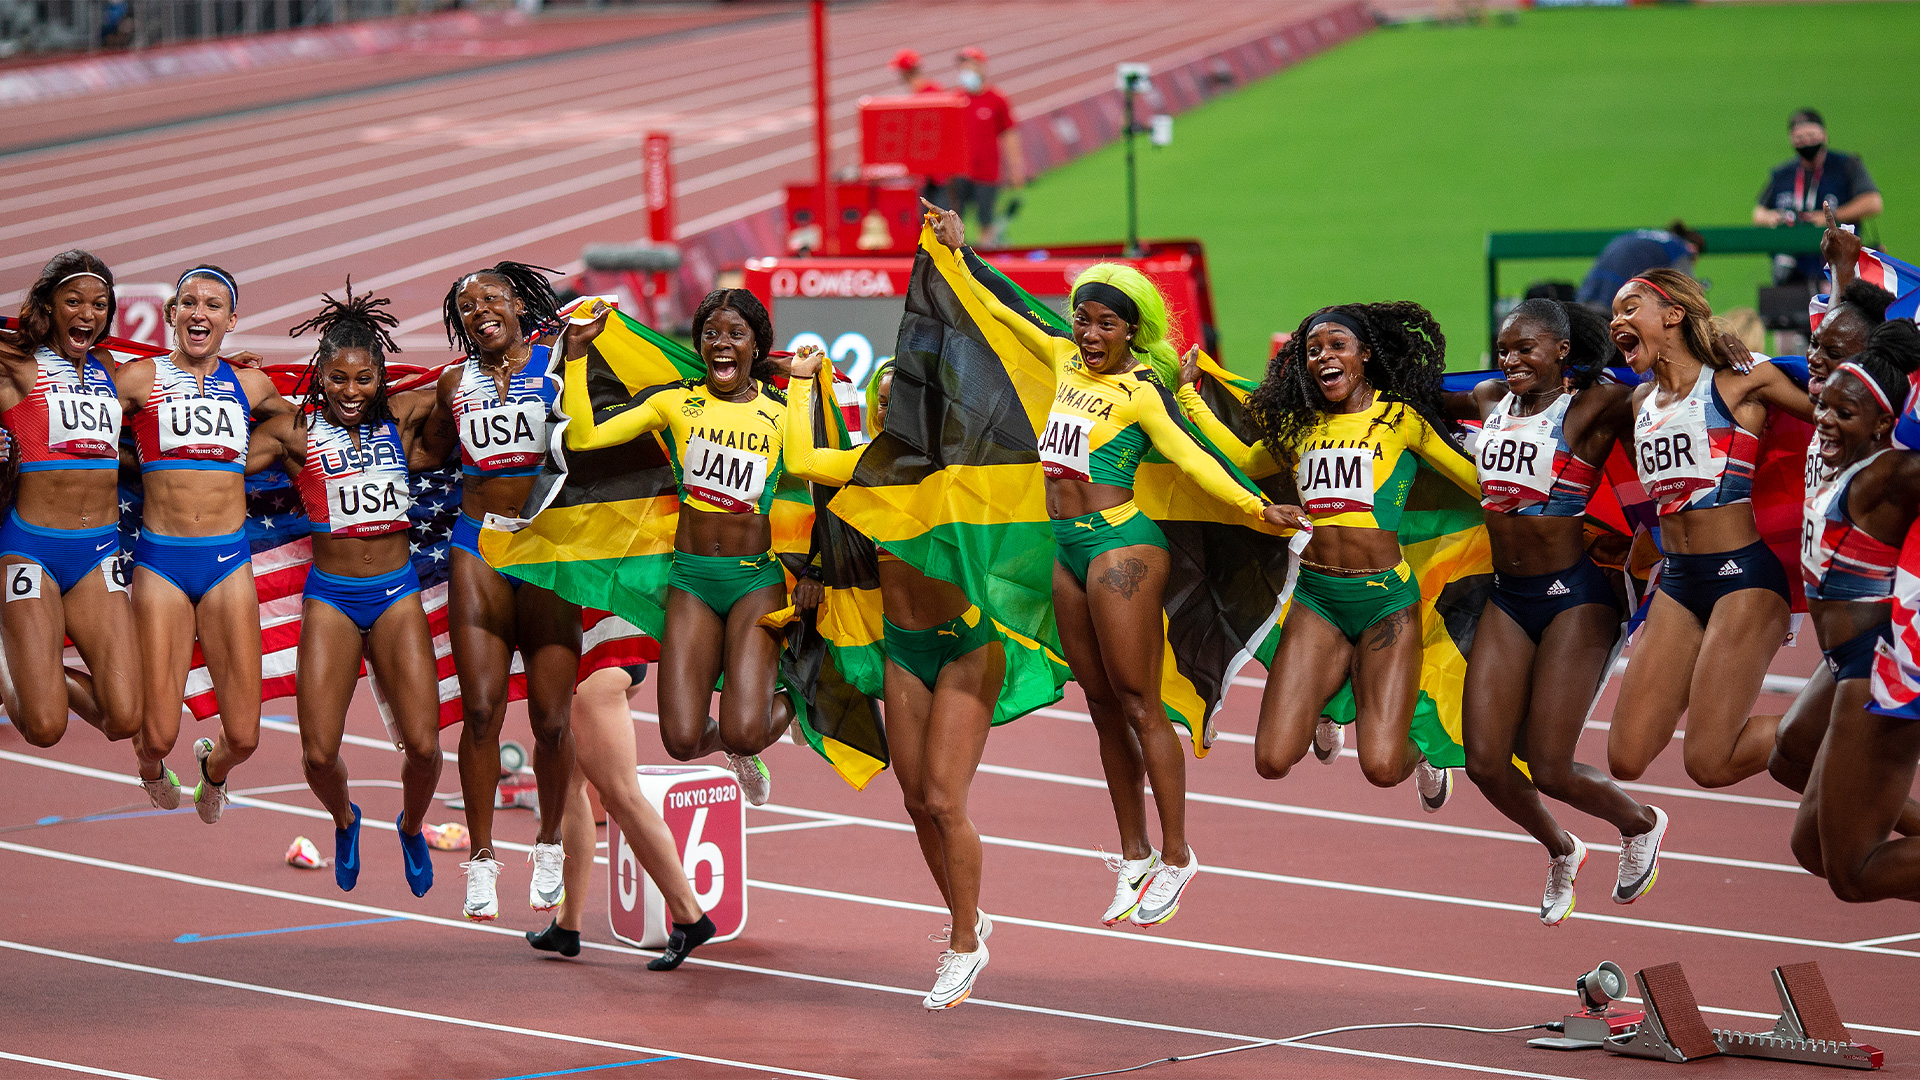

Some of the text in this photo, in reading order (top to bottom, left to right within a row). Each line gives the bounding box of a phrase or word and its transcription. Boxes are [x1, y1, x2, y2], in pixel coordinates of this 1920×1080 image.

[801, 269, 895, 297] OMEGA
[124, 301, 159, 347] 2
[59, 400, 114, 434] USA
[1056, 382, 1114, 421] JAMAICA
[171, 405, 234, 438] USA
[470, 411, 535, 449] USA
[1039, 420, 1082, 457] JAM
[320, 442, 399, 476] USA
[692, 448, 754, 492] JAM
[1482, 439, 1538, 477] GBR
[1640, 433, 1696, 475] GBR
[1804, 452, 1824, 489] BR
[1301, 456, 1362, 491] JAM
[338, 482, 399, 515] USA
[12, 567, 33, 596] 6
[111, 560, 126, 588] 6
[1718, 567, 1743, 576] adidas
[1547, 587, 1571, 596] adidas
[668, 784, 737, 809] TOKYO 2020
[617, 829, 638, 913] 6
[682, 807, 725, 913] 6
